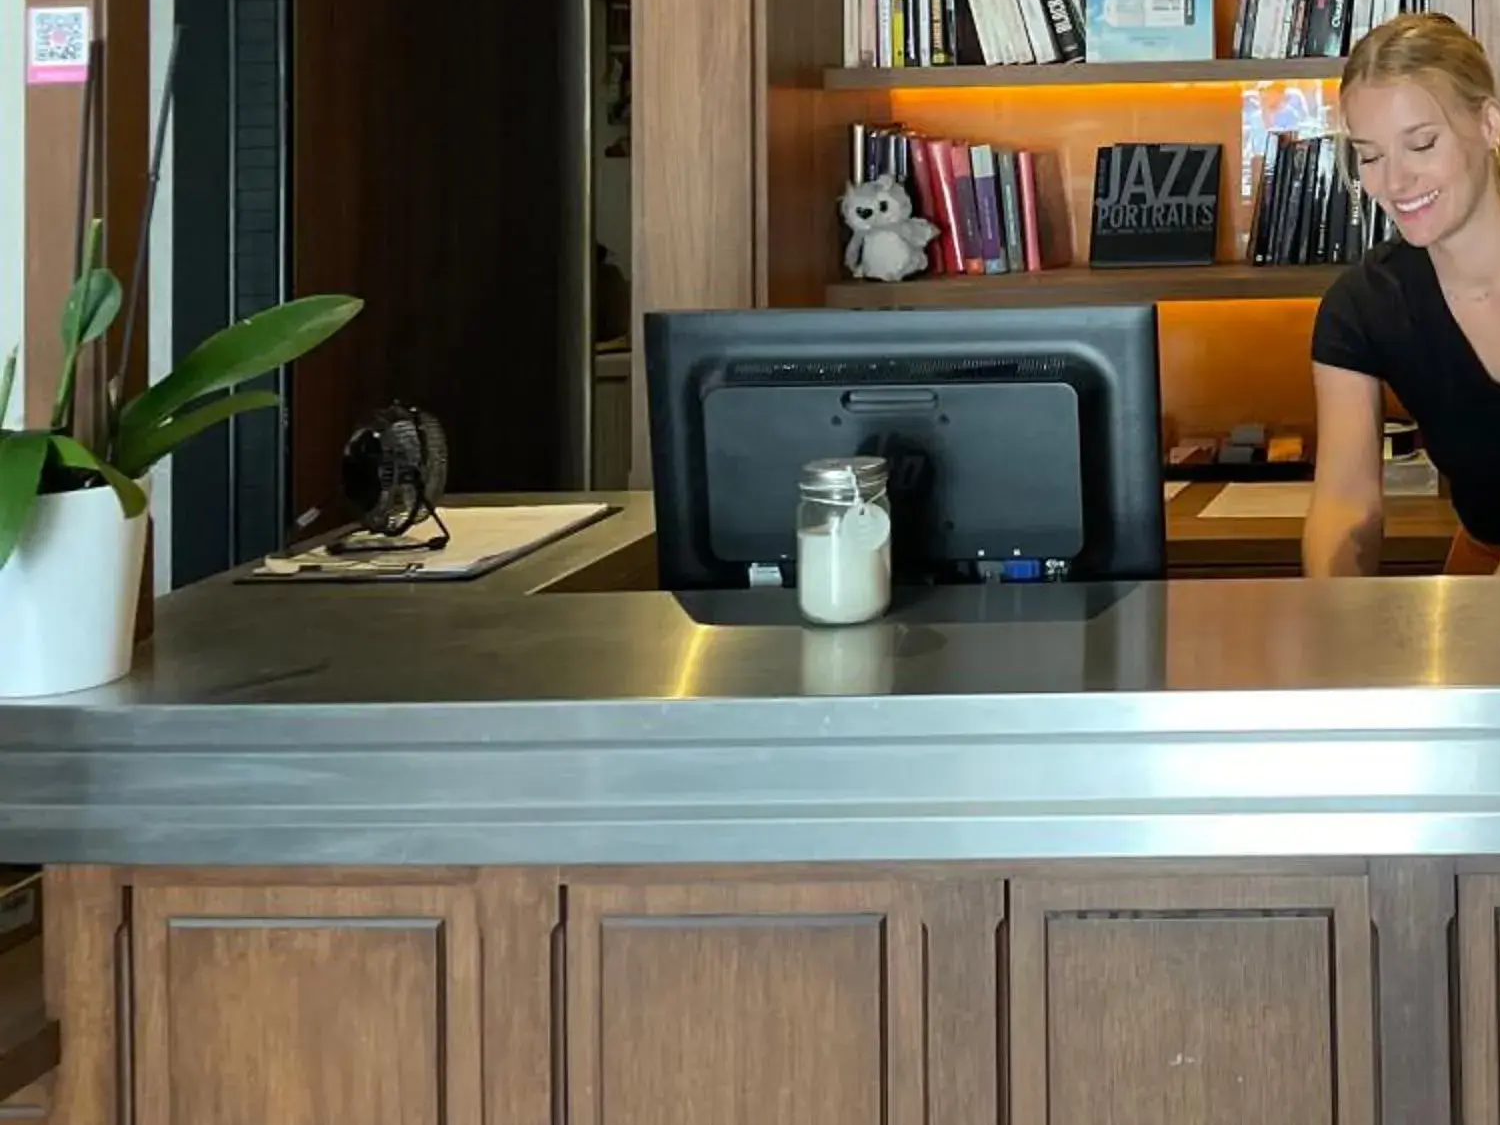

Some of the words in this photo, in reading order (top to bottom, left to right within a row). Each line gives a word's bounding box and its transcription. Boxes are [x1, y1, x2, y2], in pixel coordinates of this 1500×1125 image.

[1047, 0, 1073, 35] BLACK
[1096, 145, 1219, 206] JAZZ
[1097, 202, 1214, 229] PORTRAITS
